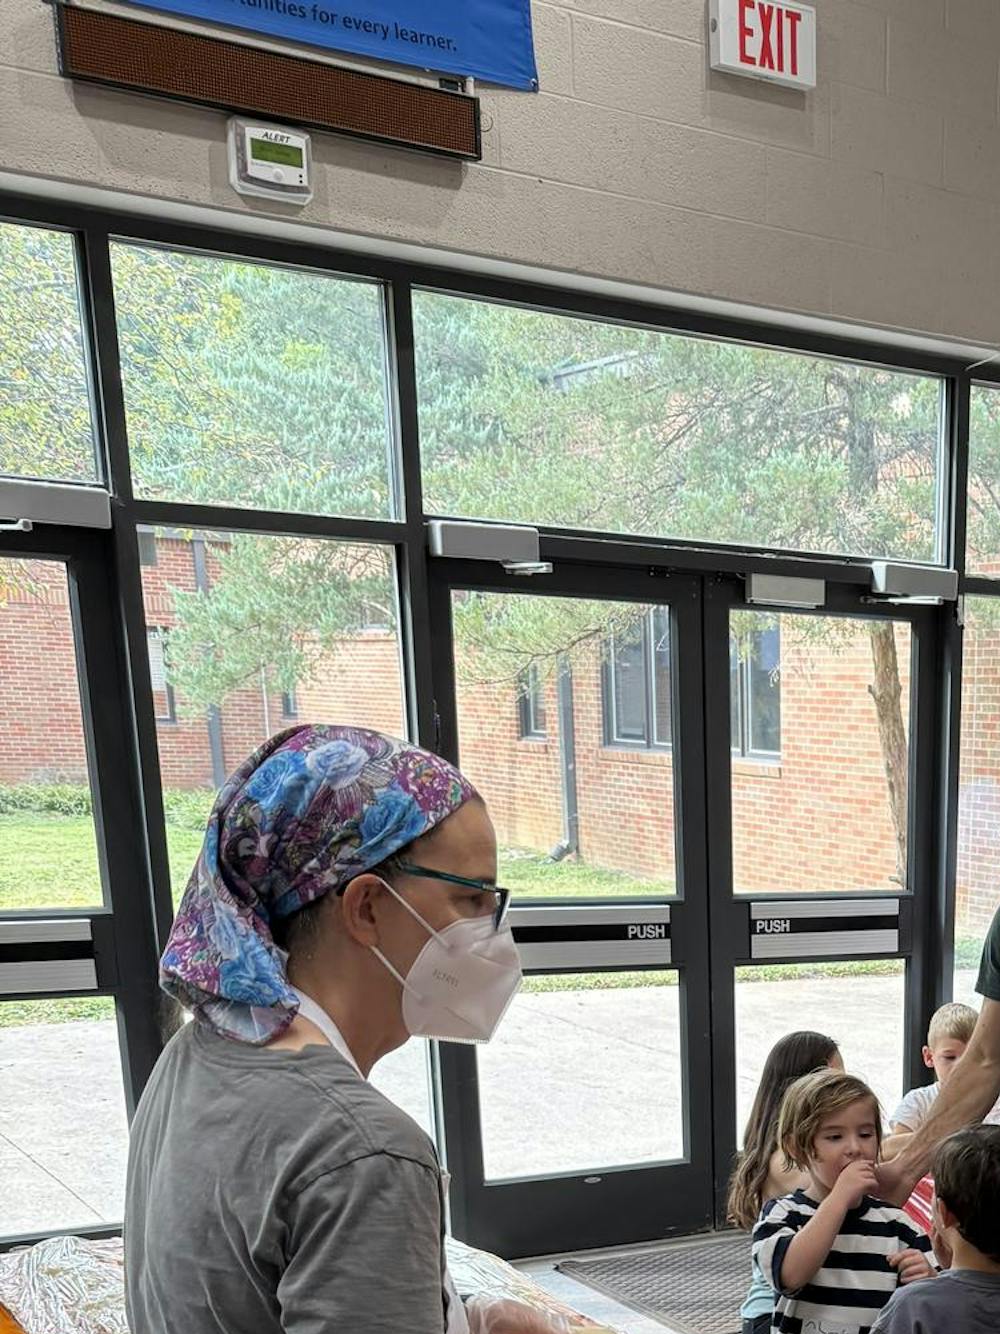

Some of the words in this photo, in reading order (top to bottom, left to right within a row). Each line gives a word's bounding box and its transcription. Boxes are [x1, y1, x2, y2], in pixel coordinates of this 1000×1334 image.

[240, 0, 306, 18] unities
[311, 4, 337, 26] for
[342, 15, 390, 40] every
[395, 21, 458, 51] learner.
[739, 0, 802, 76] EXIT
[262, 131, 291, 144] ALERT
[628, 924, 666, 939] PUSH
[756, 919, 791, 934] PUSH
